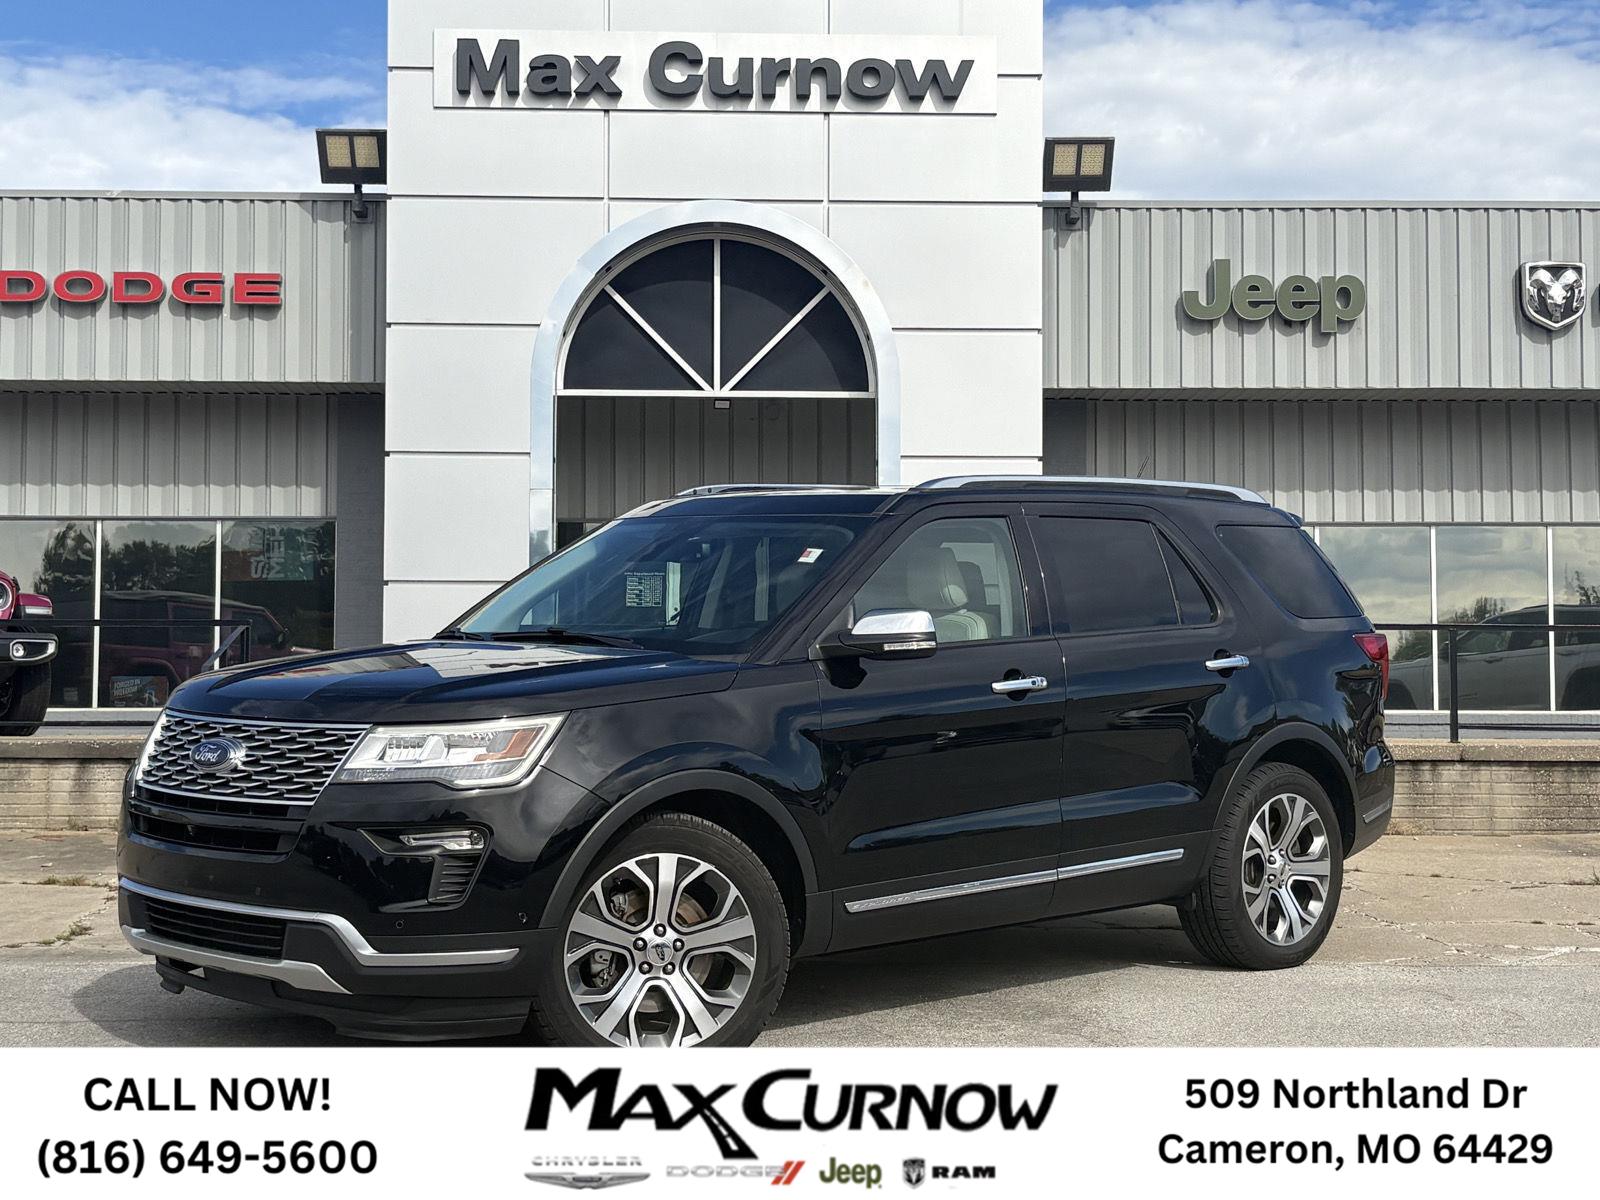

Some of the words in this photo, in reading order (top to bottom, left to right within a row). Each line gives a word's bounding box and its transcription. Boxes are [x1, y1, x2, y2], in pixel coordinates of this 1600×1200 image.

[455, 38, 622, 98] Max
[648, 41, 974, 101] Curnow
[0, 270, 282, 304] DODGE
[1182, 259, 1366, 333] Jeep
[195, 743, 222, 762] Ford
